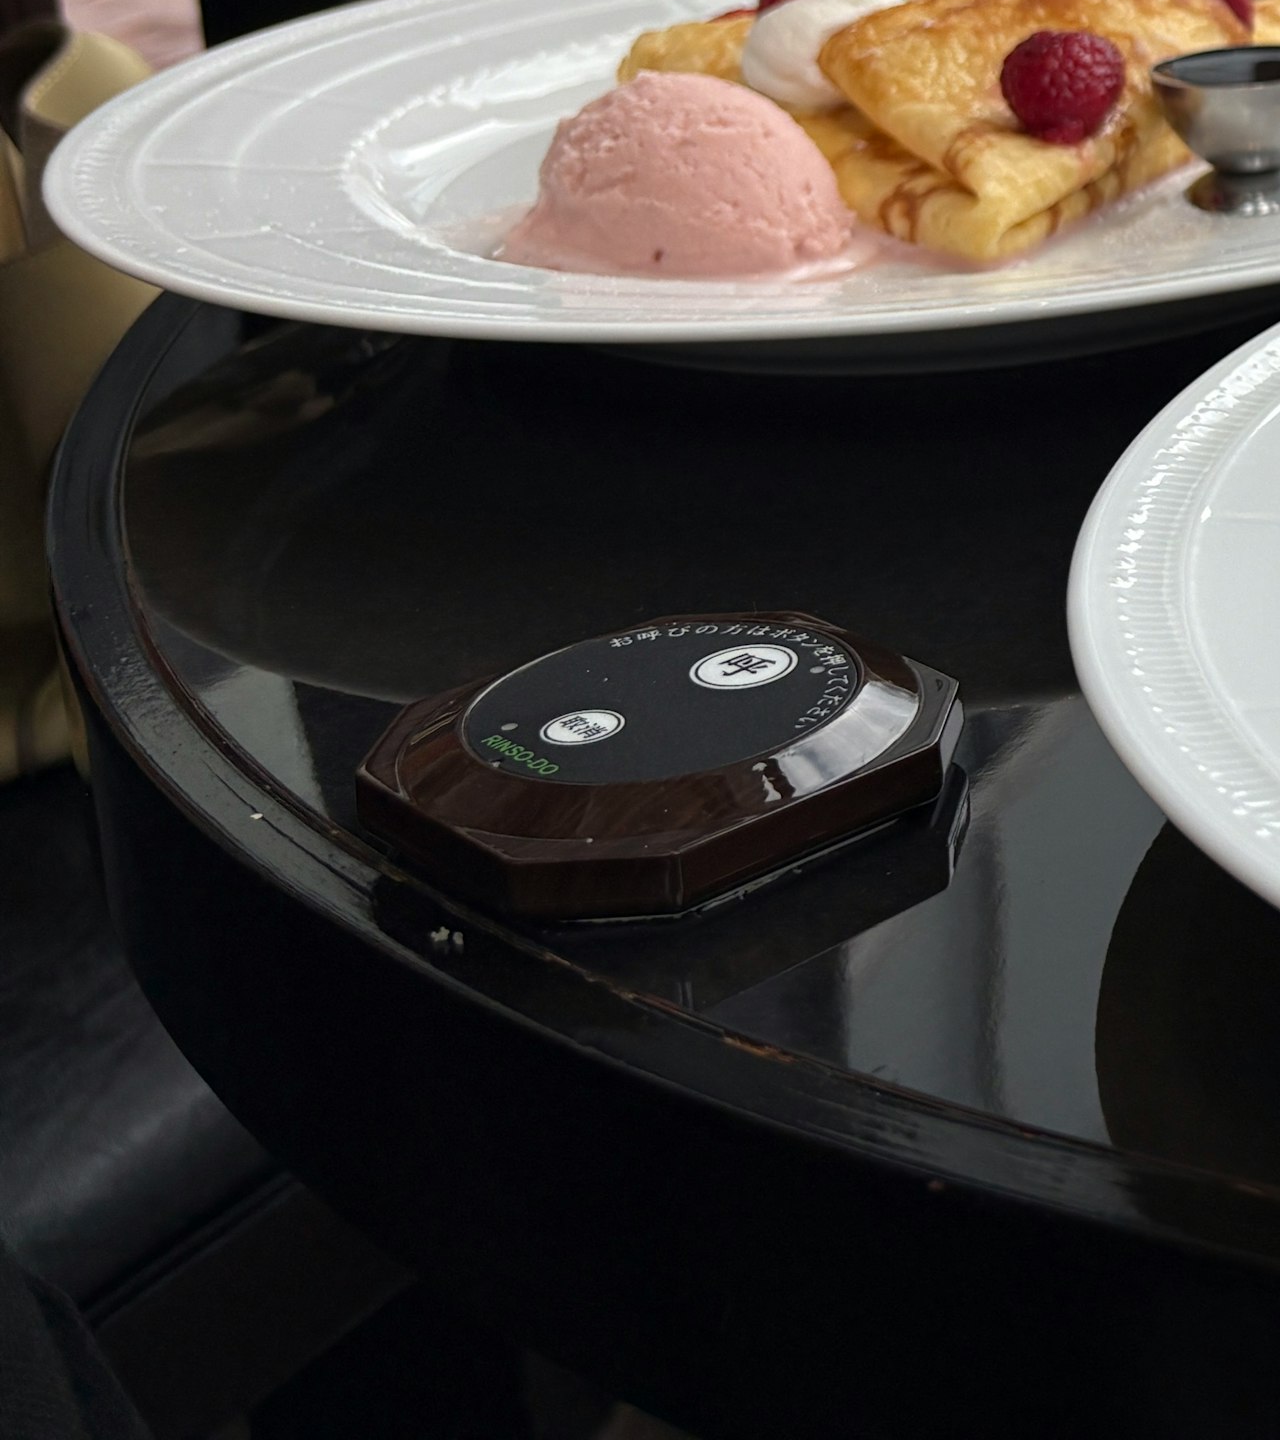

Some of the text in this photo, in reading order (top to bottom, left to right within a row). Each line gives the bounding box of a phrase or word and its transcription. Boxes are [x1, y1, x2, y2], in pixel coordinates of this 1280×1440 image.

[609, 624, 849, 729] お呼びの方はボタンを押してください
[719, 652, 777, 677] 呼
[561, 715, 608, 739] 取消
[481, 734, 560, 776] RINSO-DO
